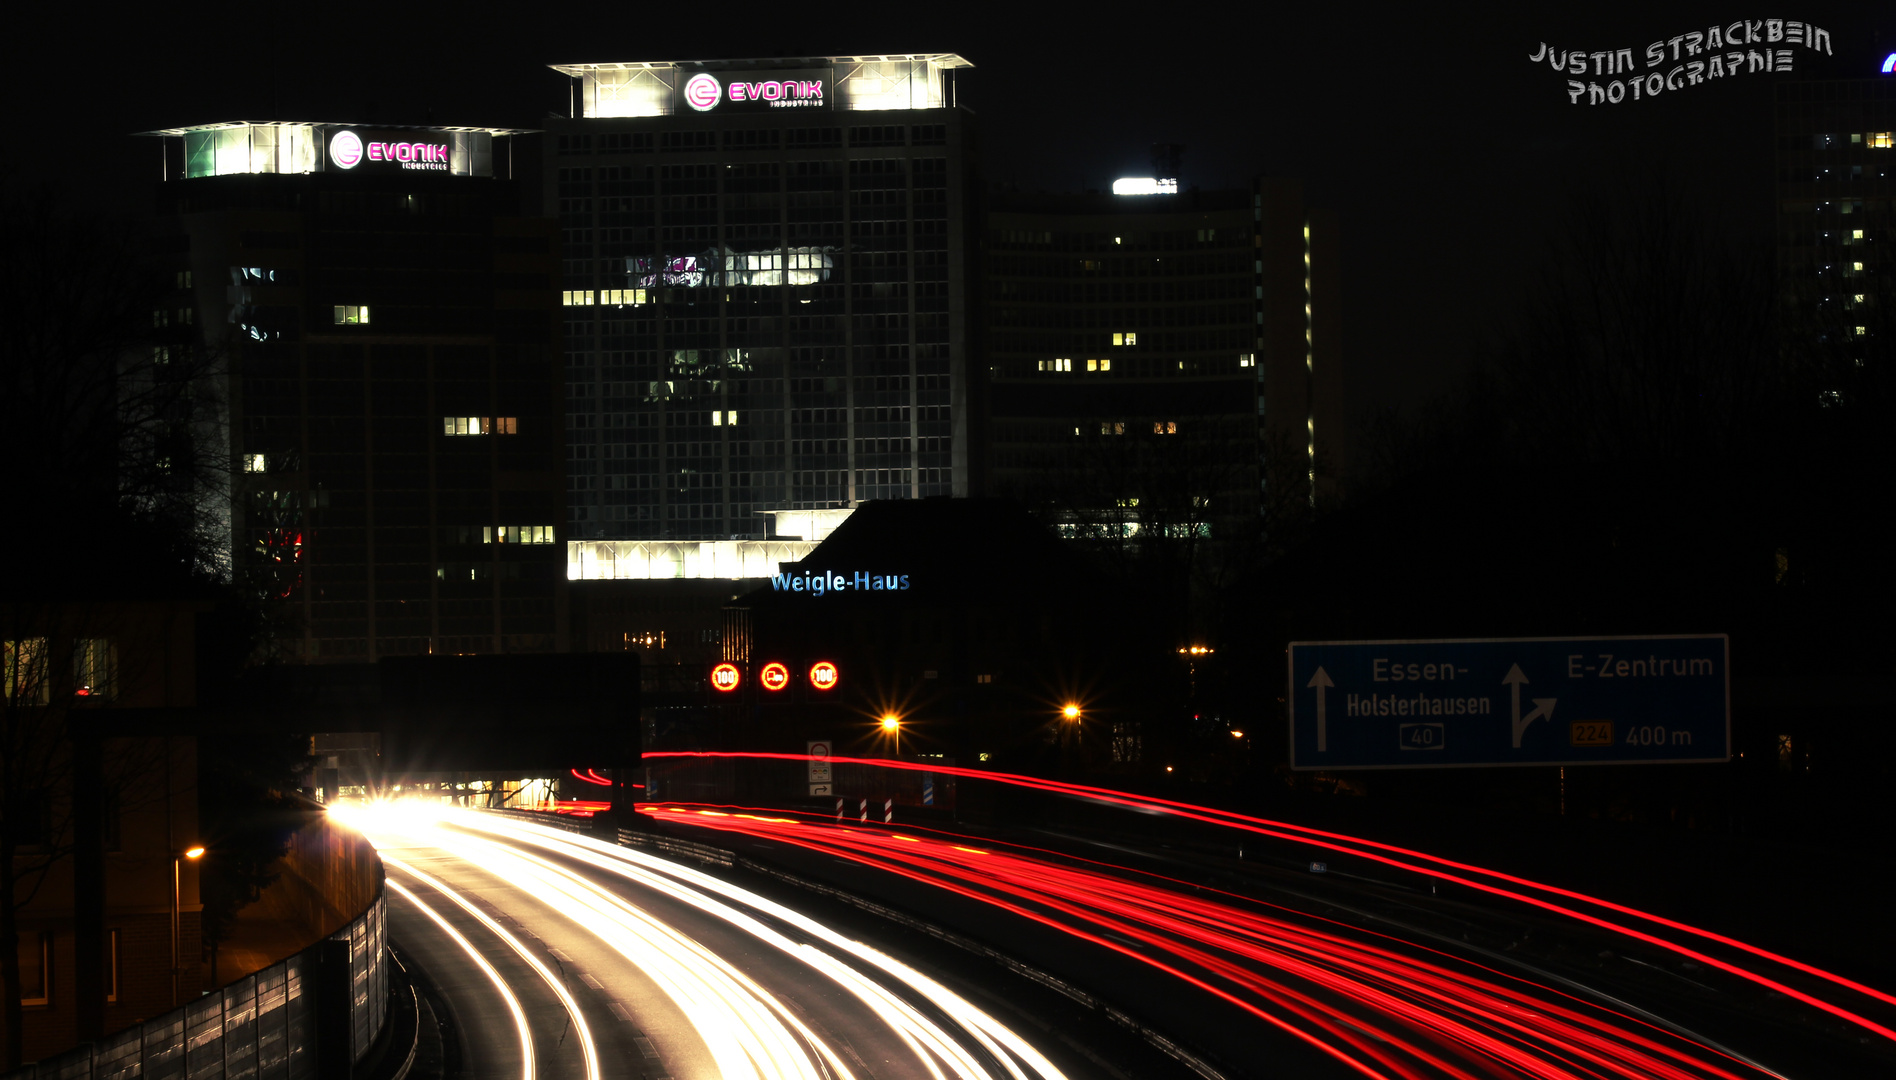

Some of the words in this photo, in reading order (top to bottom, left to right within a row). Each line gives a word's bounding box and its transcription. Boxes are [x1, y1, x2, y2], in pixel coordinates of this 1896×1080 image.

[728, 80, 823, 101] EVONIK
[367, 142, 448, 163] EVONIK
[771, 570, 910, 597] Weigle-Haus
[815, 669, 833, 682] 100
[1372, 658, 1469, 682] Essen-
[1567, 654, 1713, 678] E-Zentrum
[716, 671, 734, 684] 100
[1347, 692, 1491, 717] Holsterhausen
[1411, 728, 1433, 744] 40
[1576, 725, 1608, 741] 224
[1625, 726, 1666, 746] 400
[1671, 730, 1692, 745] m
